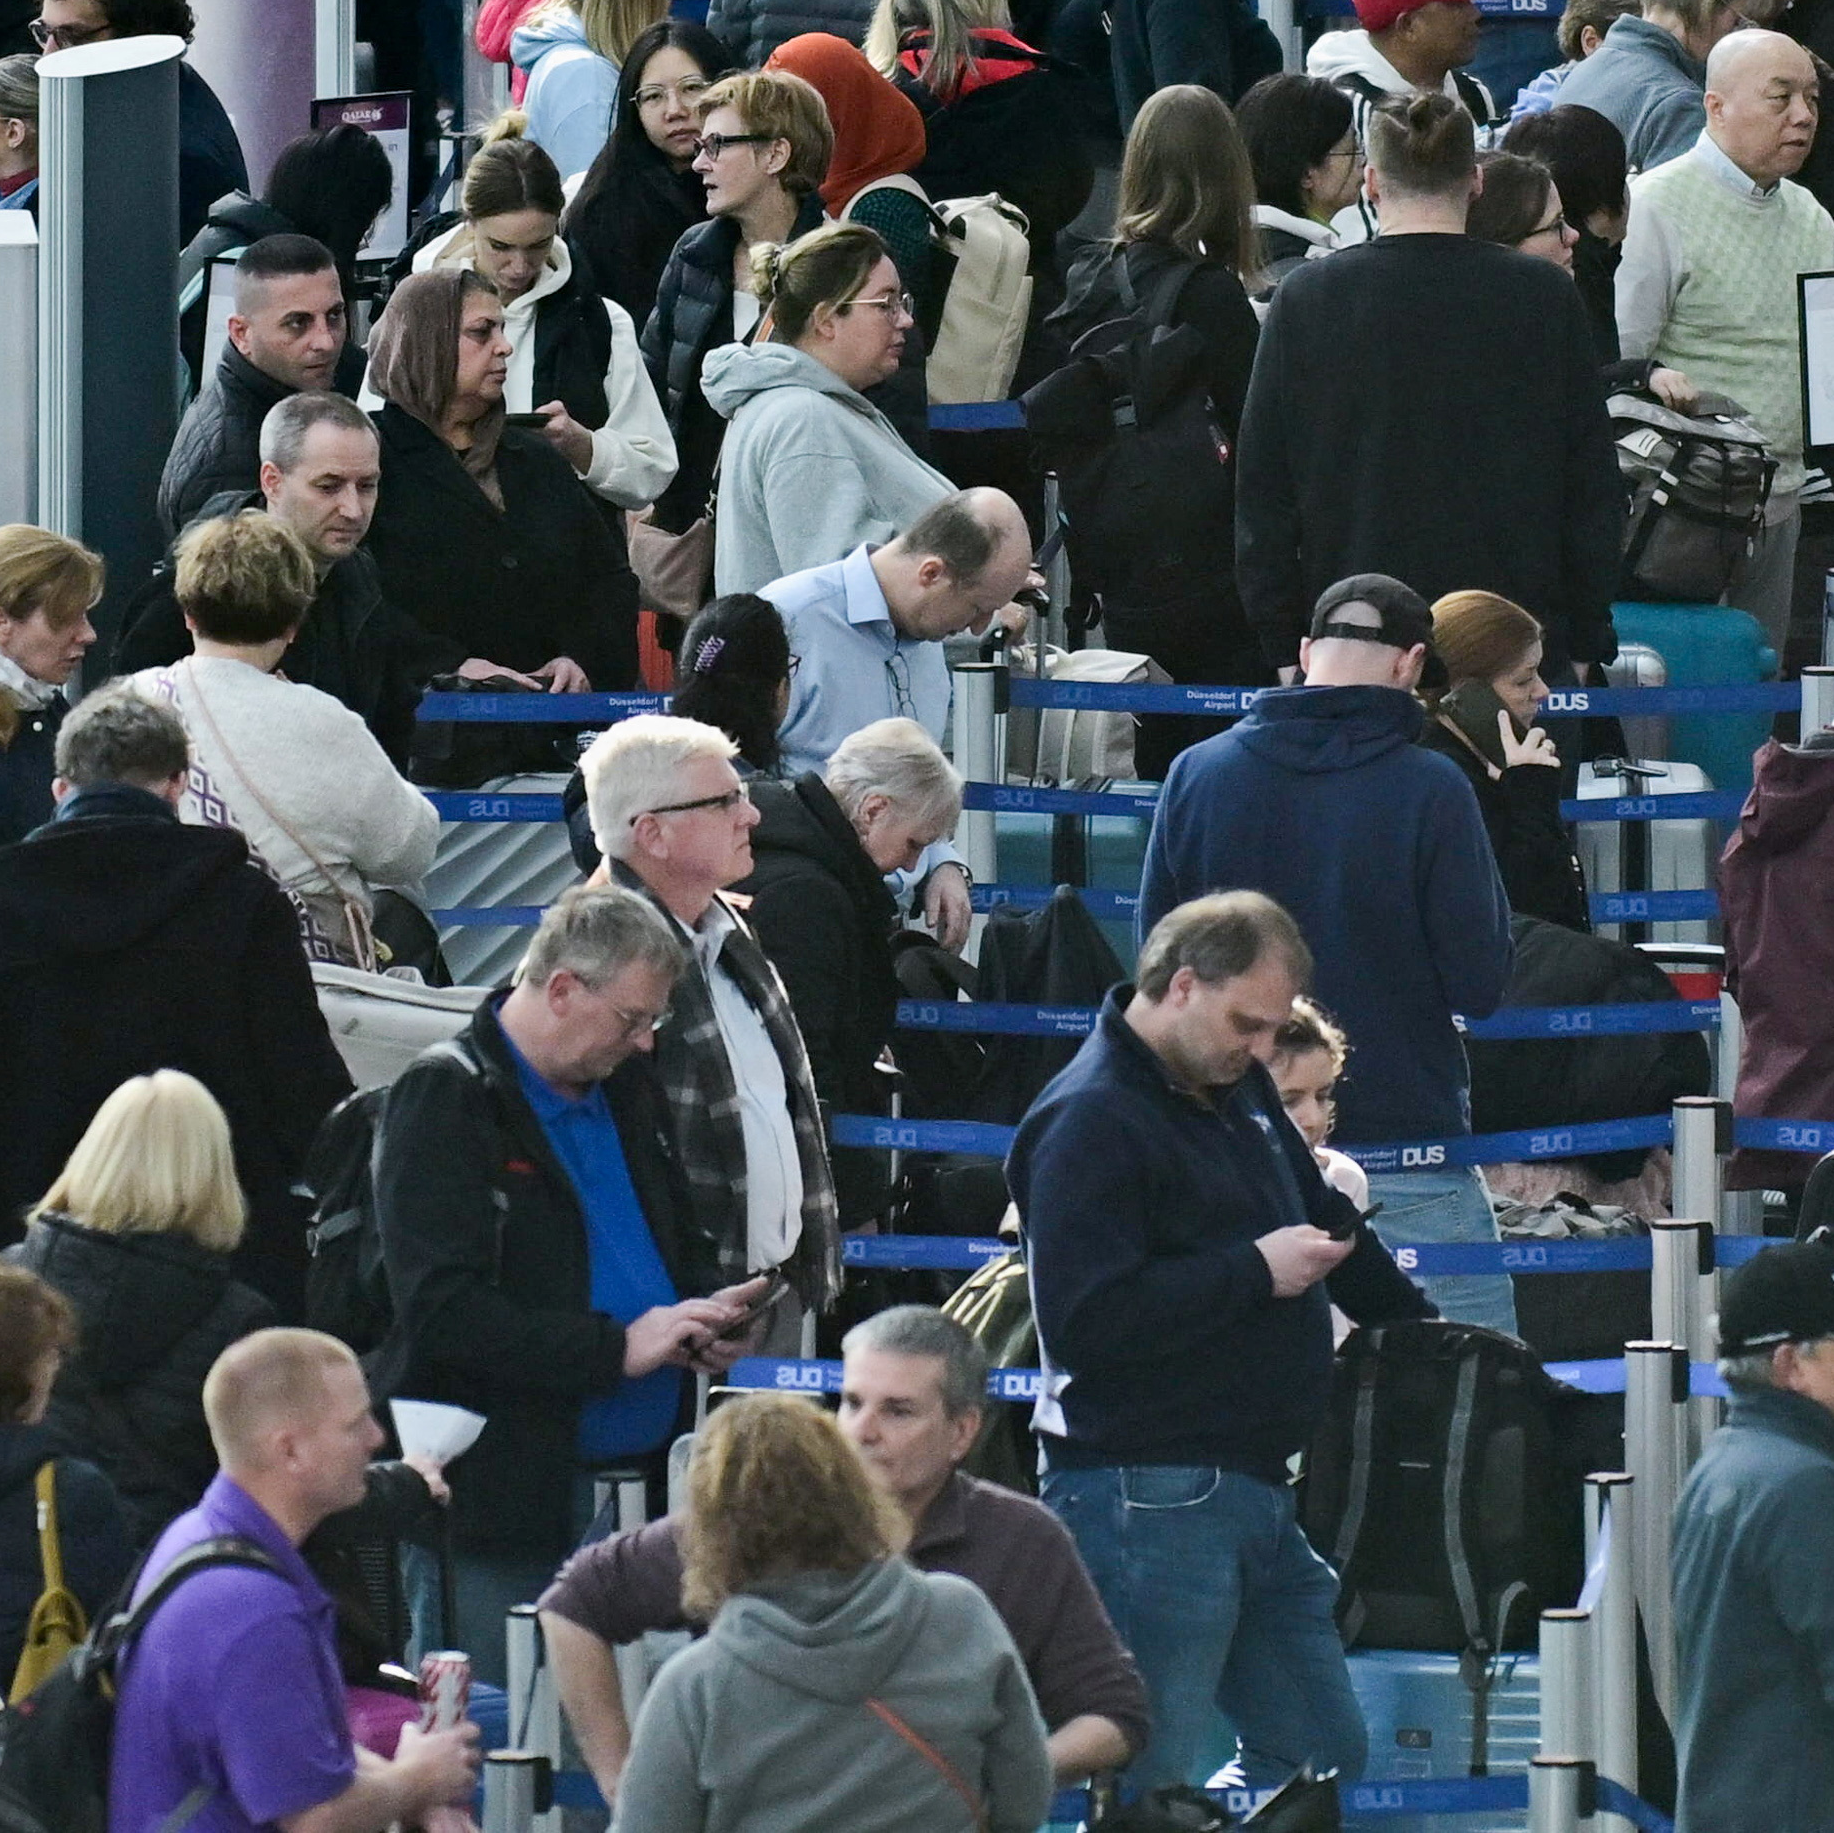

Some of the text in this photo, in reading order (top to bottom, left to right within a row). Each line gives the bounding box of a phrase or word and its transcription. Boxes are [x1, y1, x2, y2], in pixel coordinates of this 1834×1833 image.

[1186, 690, 1237, 700] Düsseldorf
[609, 697, 659, 707] Düsseldorf
[1204, 699, 1237, 711] Airport
[1547, 692, 1590, 712] DUS
[1036, 1010, 1090, 1021] Düsseldorf
[1401, 1144, 1446, 1167] DUS
